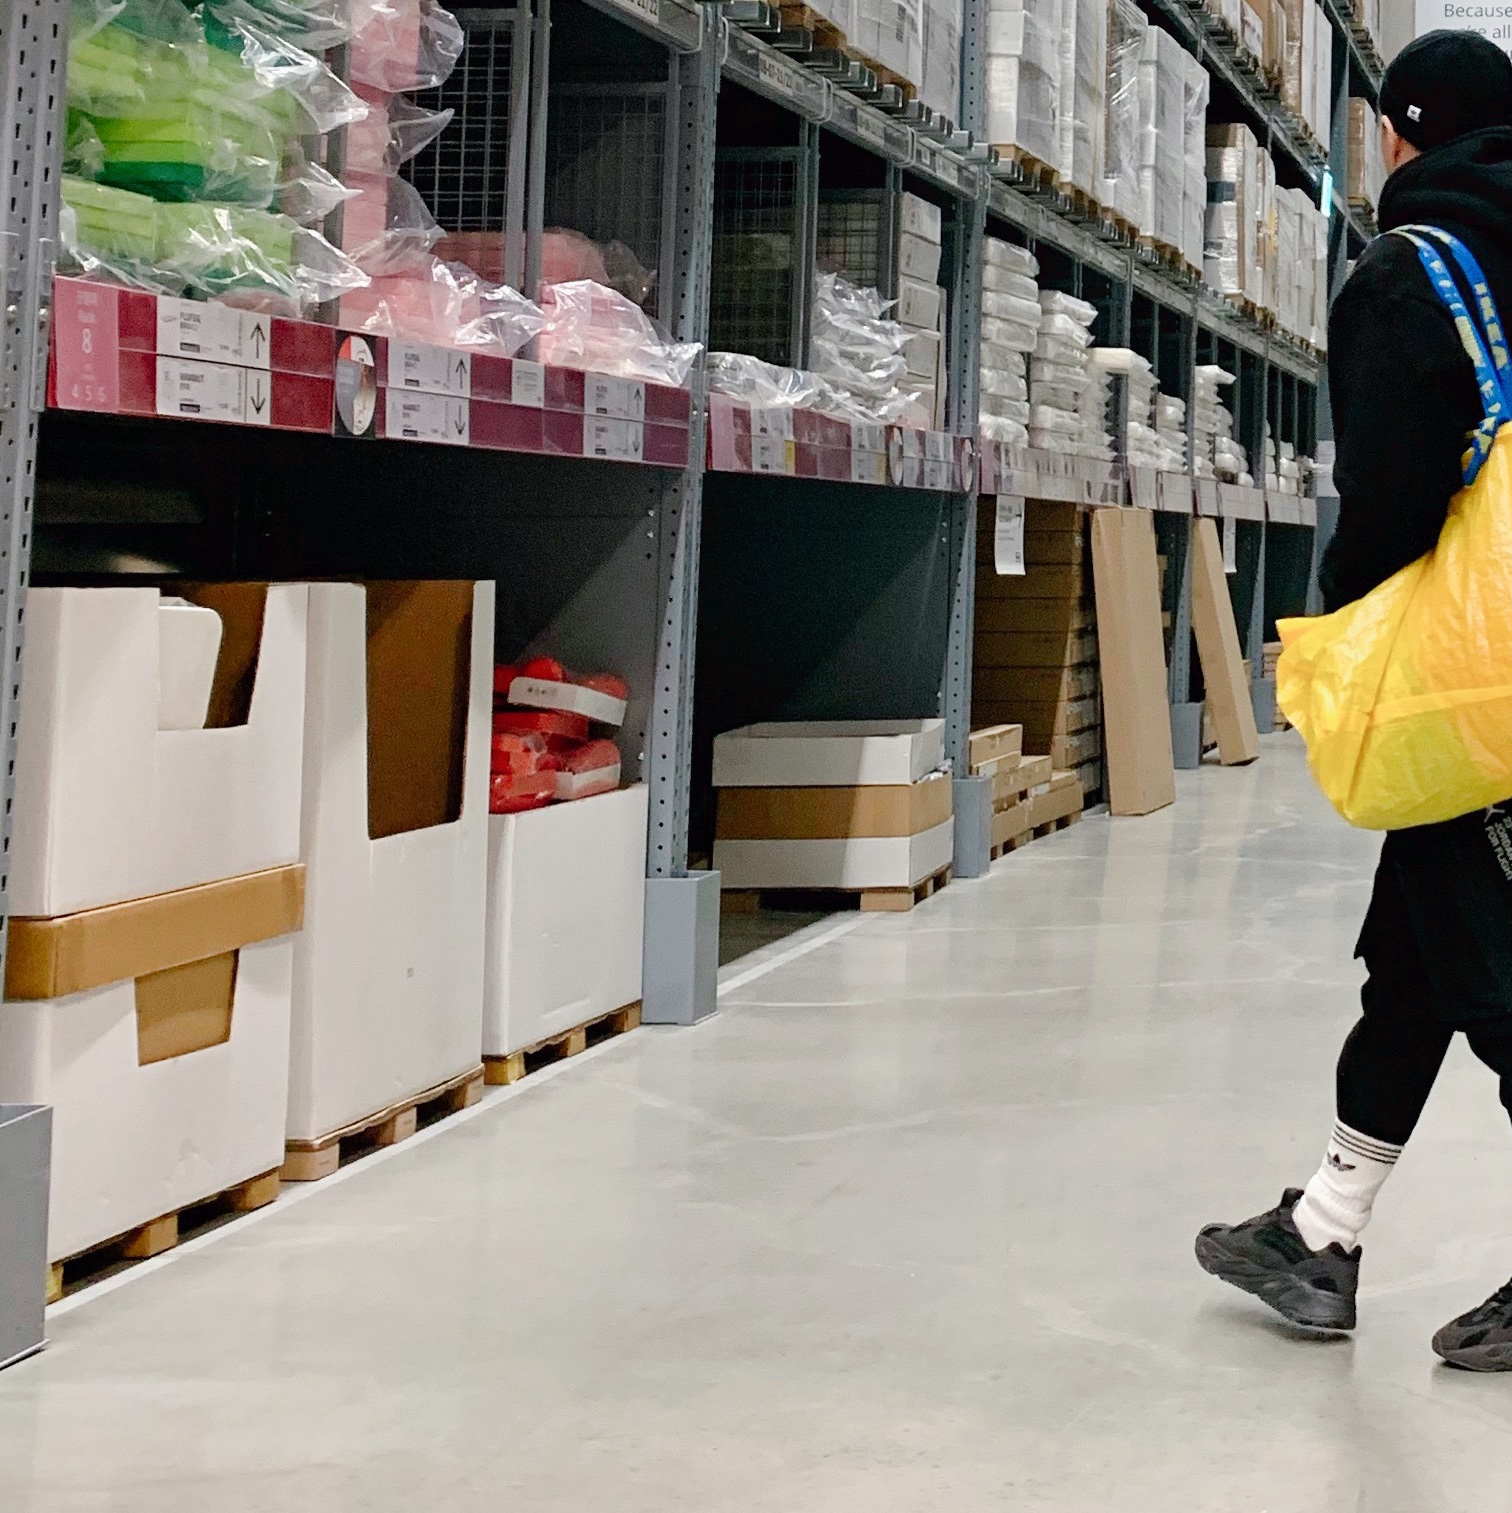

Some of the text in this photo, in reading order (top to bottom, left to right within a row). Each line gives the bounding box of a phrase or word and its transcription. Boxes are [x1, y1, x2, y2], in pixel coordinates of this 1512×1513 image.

[1492, 24, 1511, 39] all
[82, 328, 92, 354] 8
[1484, 825, 1500, 848] FOR
